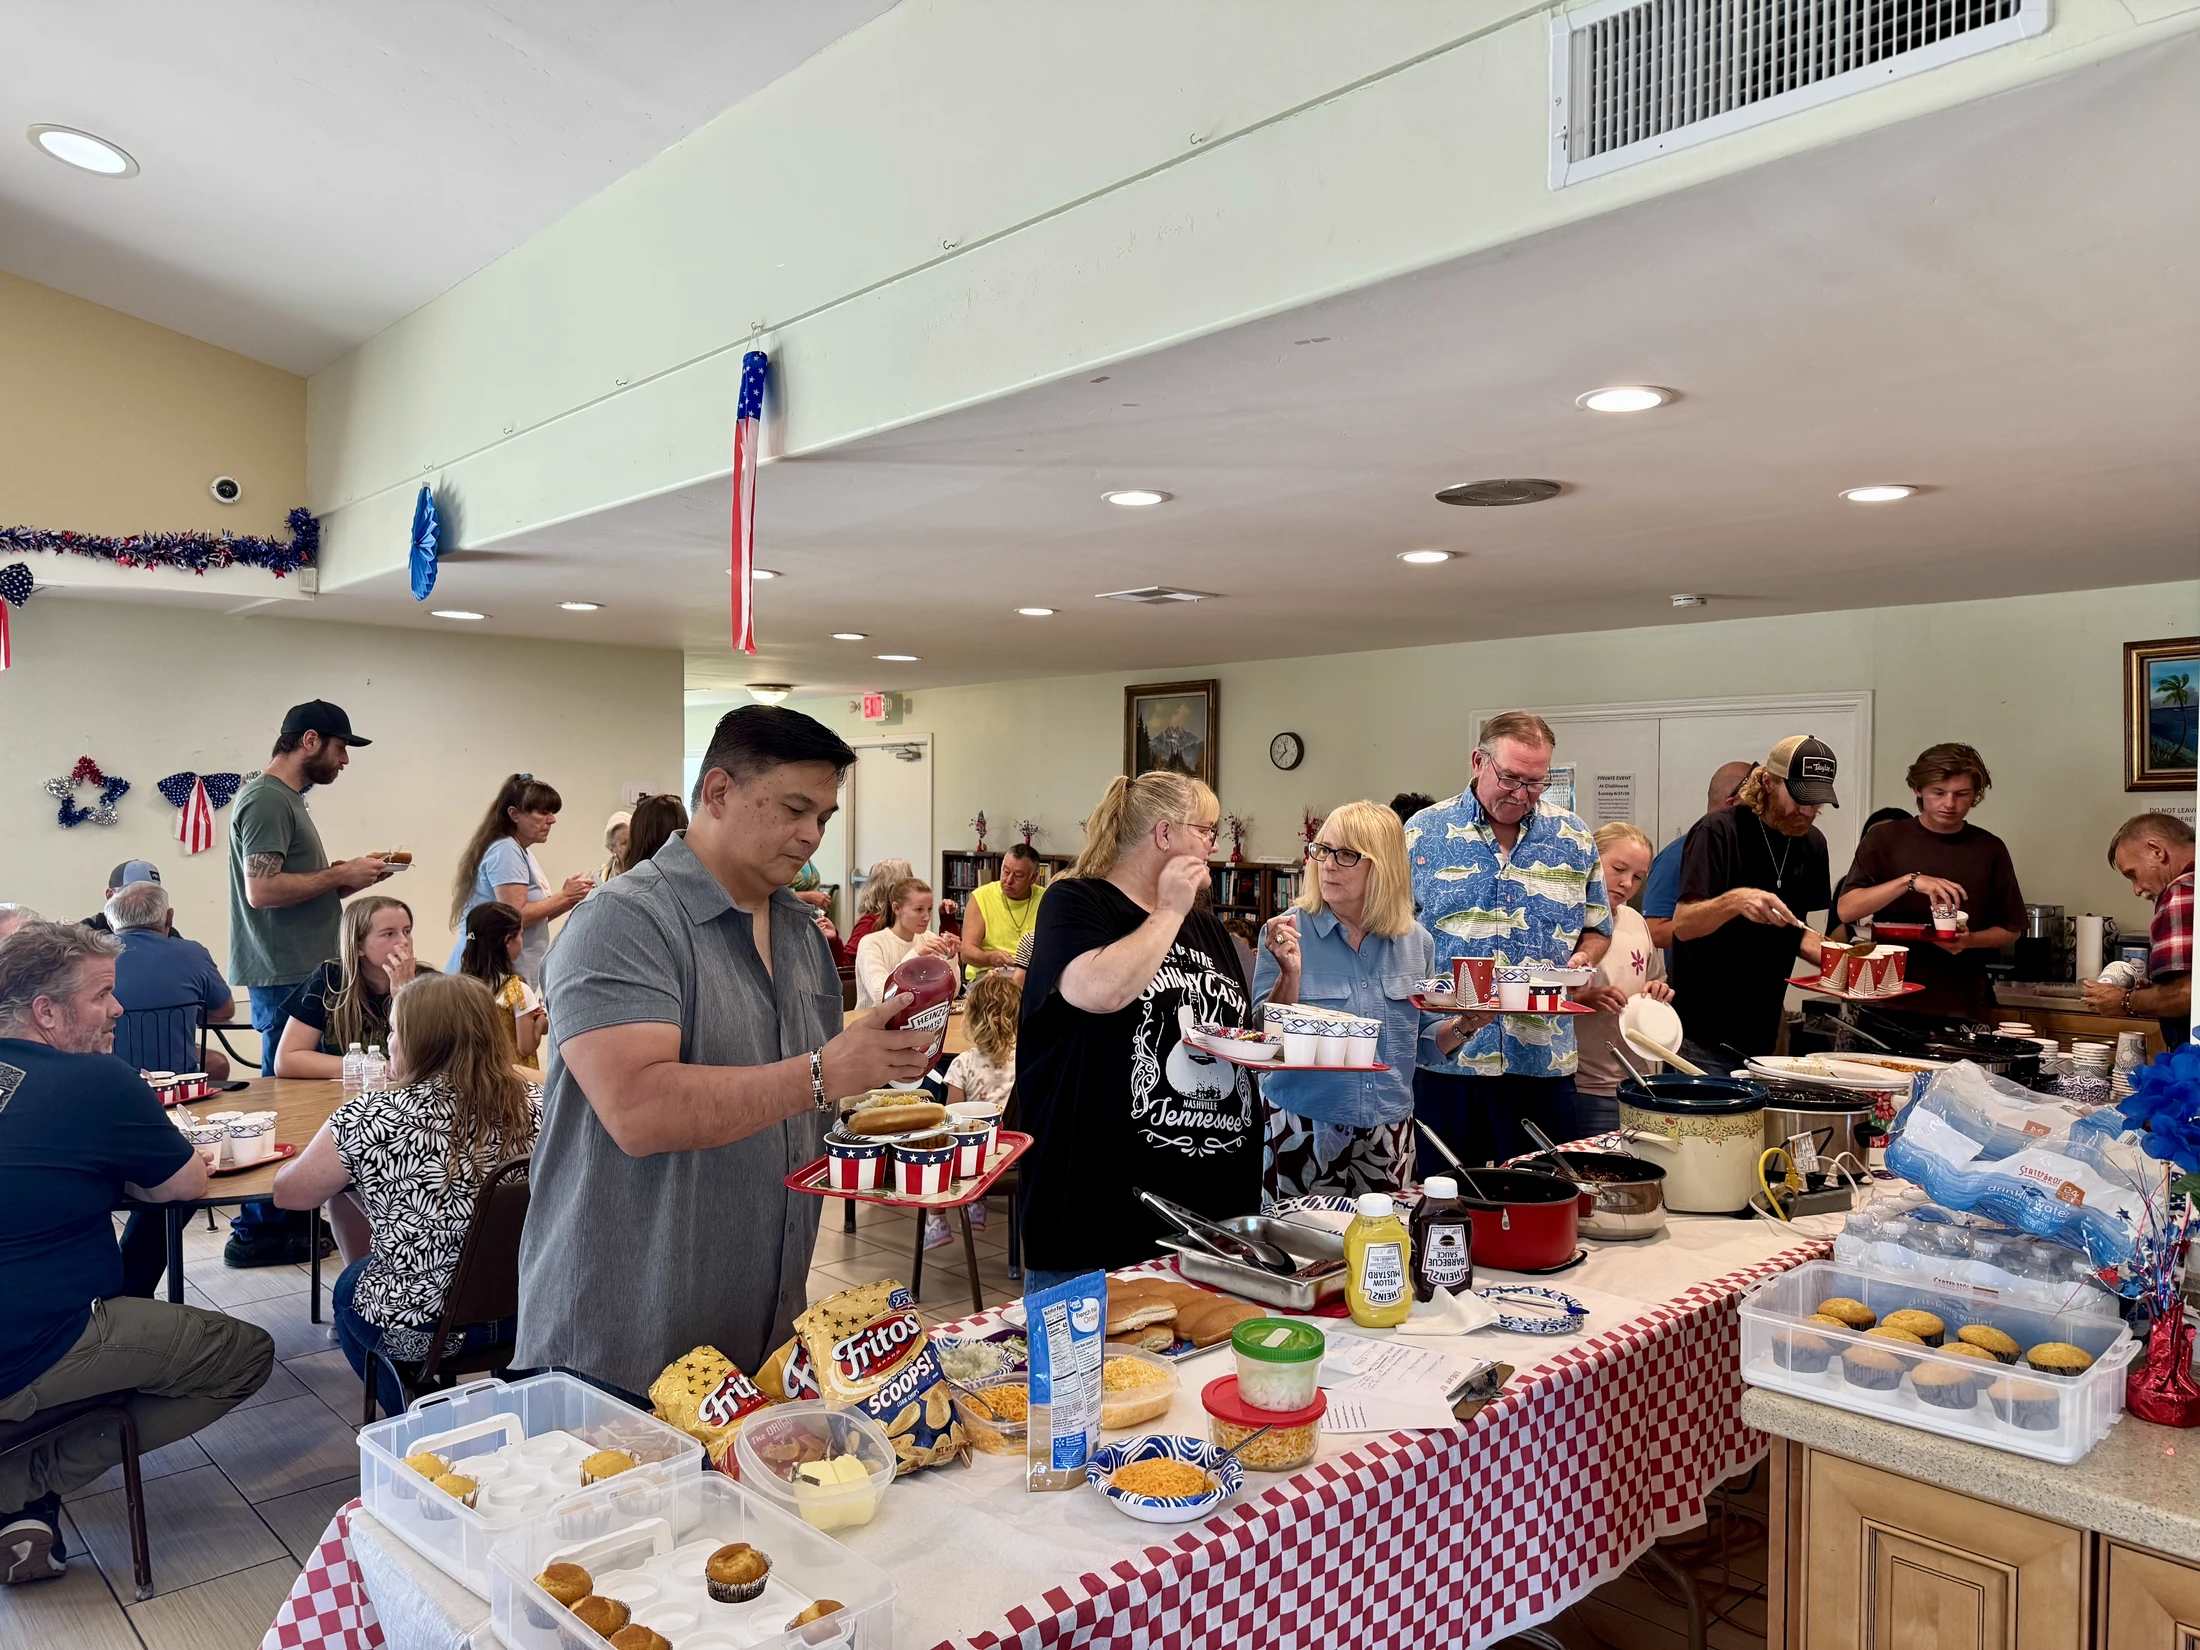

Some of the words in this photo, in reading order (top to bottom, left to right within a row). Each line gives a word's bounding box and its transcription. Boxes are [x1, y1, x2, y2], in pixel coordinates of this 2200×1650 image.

[1189, 947, 1215, 970] FIRE
[1205, 974, 1247, 1018] CASH
[916, 1005, 948, 1026] HEINZ
[1183, 1099, 1218, 1111] NASHVILLE
[1149, 1097, 1243, 1132] Tennessee
[1428, 1257, 1465, 1267] BARBECUE
[1437, 1251, 1458, 1259] SAUCE
[1367, 1269, 1401, 1279] MUSTARD
[1432, 1270, 1461, 1281] HEINZ
[1373, 1279, 1397, 1287] YELLOW
[1372, 1290, 1398, 1301] HEINZ
[832, 1314, 921, 1380] Fritos
[868, 1350, 936, 1415] SCOOPS!
[698, 1373, 758, 1428] Frit
